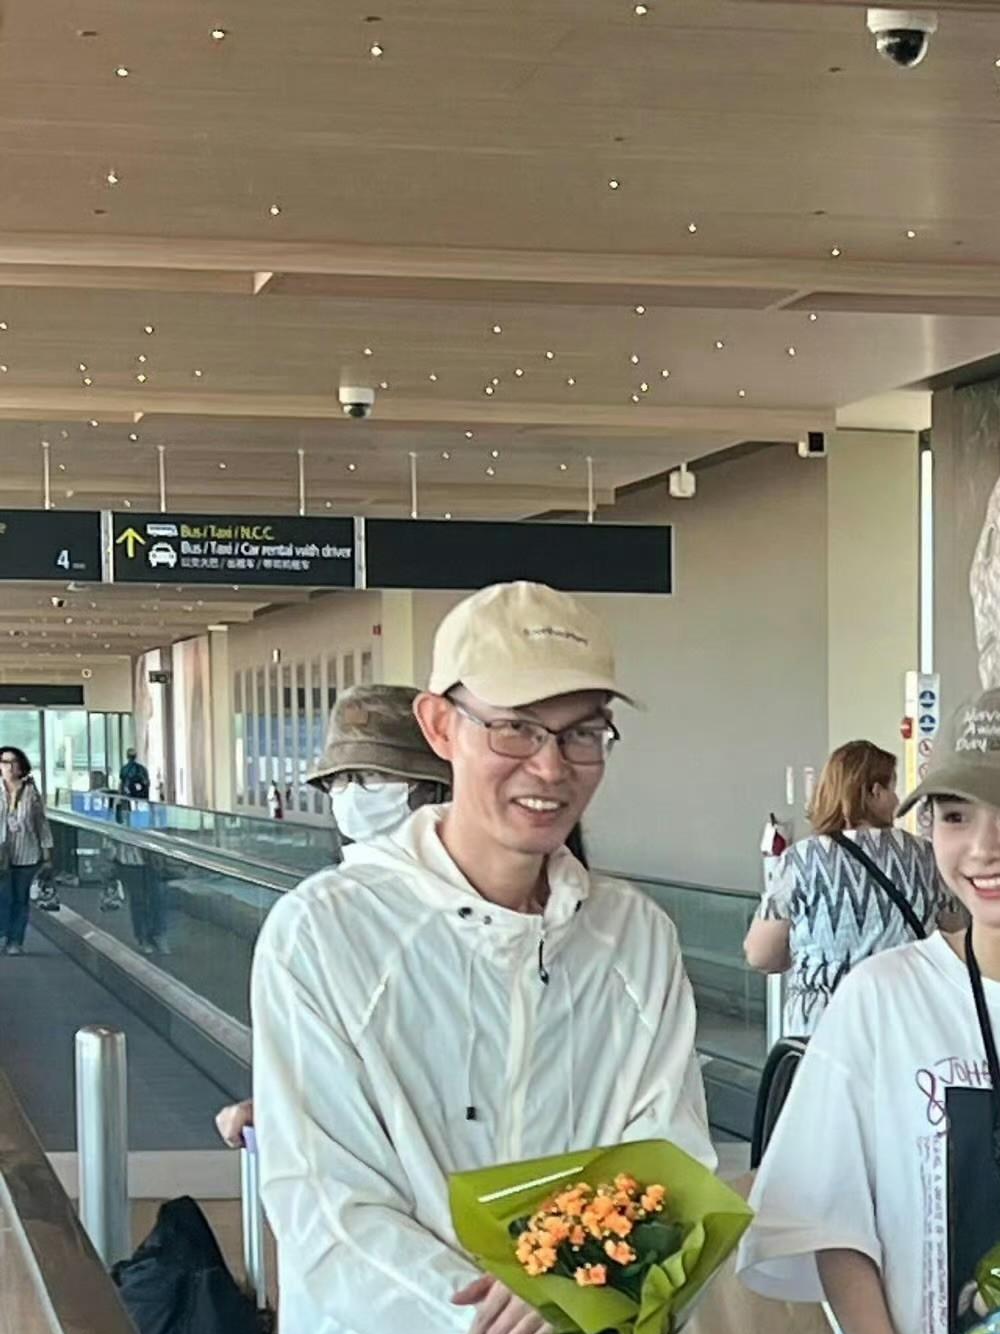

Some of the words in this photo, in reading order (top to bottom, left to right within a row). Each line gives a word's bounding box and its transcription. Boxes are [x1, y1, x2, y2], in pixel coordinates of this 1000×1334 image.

[180, 524, 202, 539] Bus
[180, 541, 202, 555] Bus
[240, 542, 260, 556] Car
[261, 543, 294, 557] rental
[321, 544, 352, 559] driver
[57, 549, 70, 570] 4
